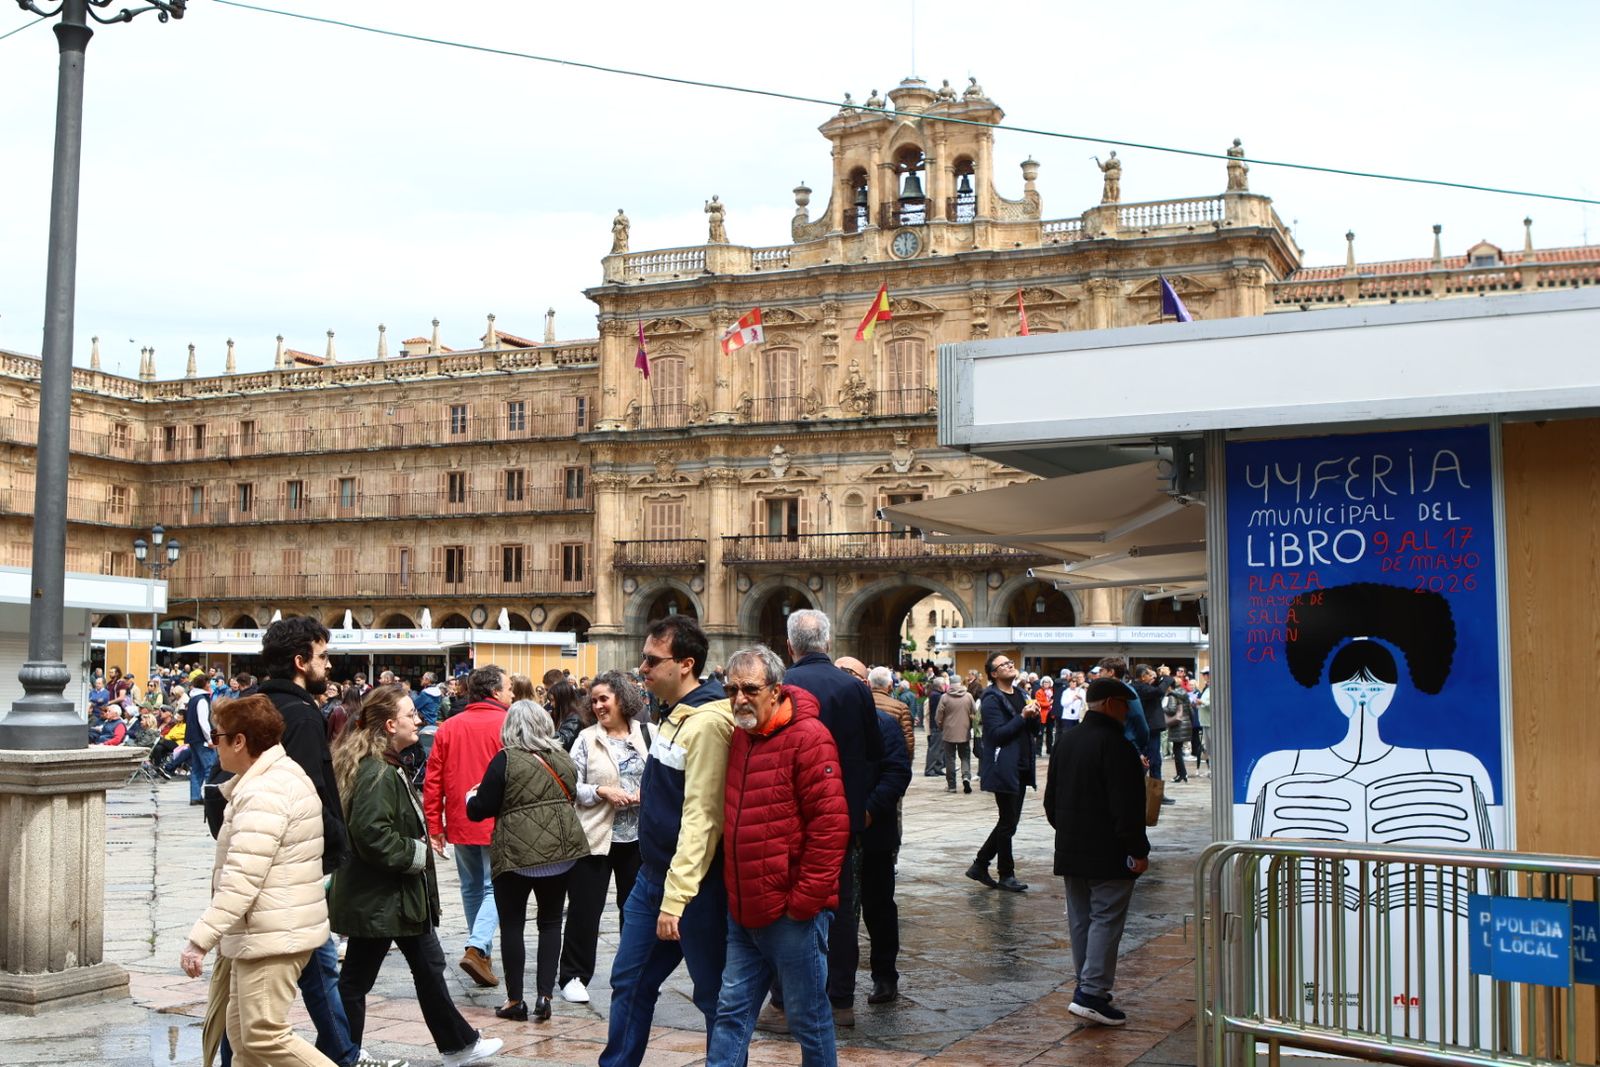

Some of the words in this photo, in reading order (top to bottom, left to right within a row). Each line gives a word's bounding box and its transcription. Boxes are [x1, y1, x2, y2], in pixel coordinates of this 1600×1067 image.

[1418, 502, 1461, 521] DEL
[1372, 531, 1389, 555] 9
[1396, 528, 1438, 553] AL
[1443, 527, 1473, 549] 17
[1381, 556, 1402, 572] DE
[1409, 552, 1481, 571] MAYO
[1248, 570, 1326, 592] PLAZA
[1414, 574, 1478, 593] 2026
[1247, 594, 1304, 607] MAYOR
[1309, 592, 1325, 606] DE
[1247, 608, 1301, 625] SALA
[1247, 627, 1298, 643] MAN
[1246, 646, 1277, 663] CA
[1496, 917, 1563, 938] POLICIA
[1500, 938, 1559, 958] LOCAL
